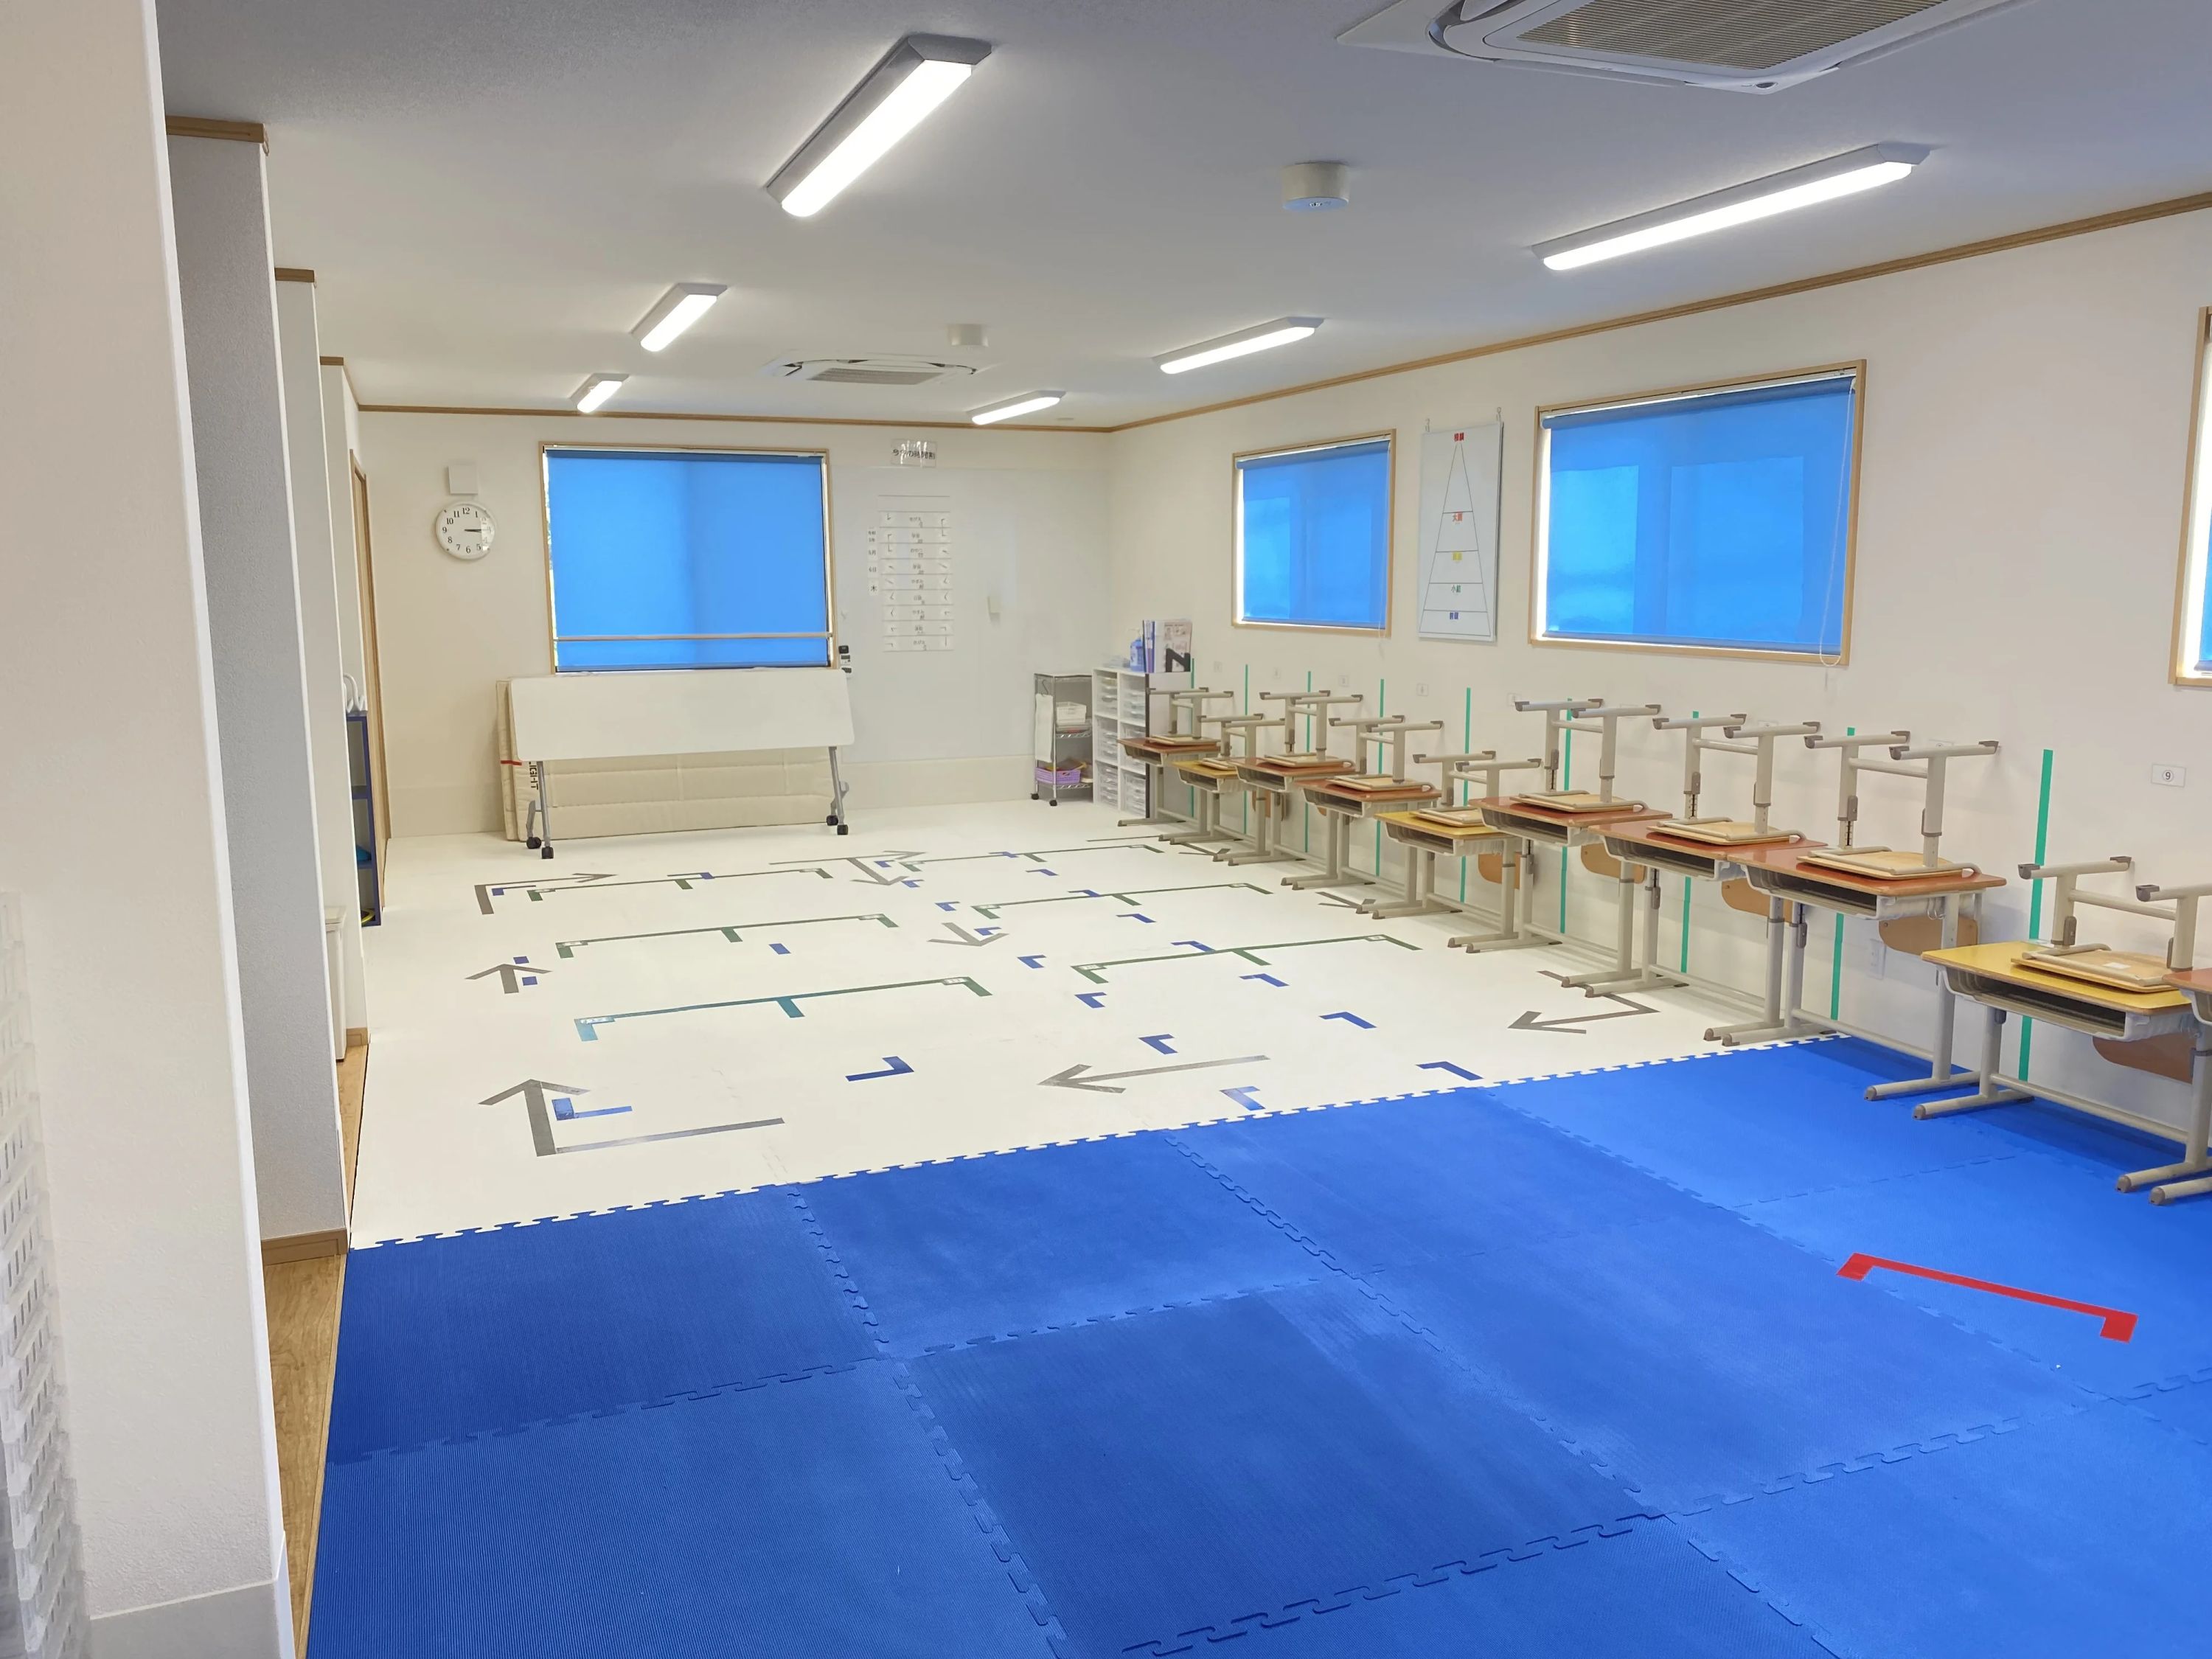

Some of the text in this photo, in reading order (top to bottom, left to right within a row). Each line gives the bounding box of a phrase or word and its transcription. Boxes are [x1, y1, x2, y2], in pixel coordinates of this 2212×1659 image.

[475, 510, 478, 518] 1
[465, 546, 471, 554] 6
[529, 761, 539, 790] IGHT
